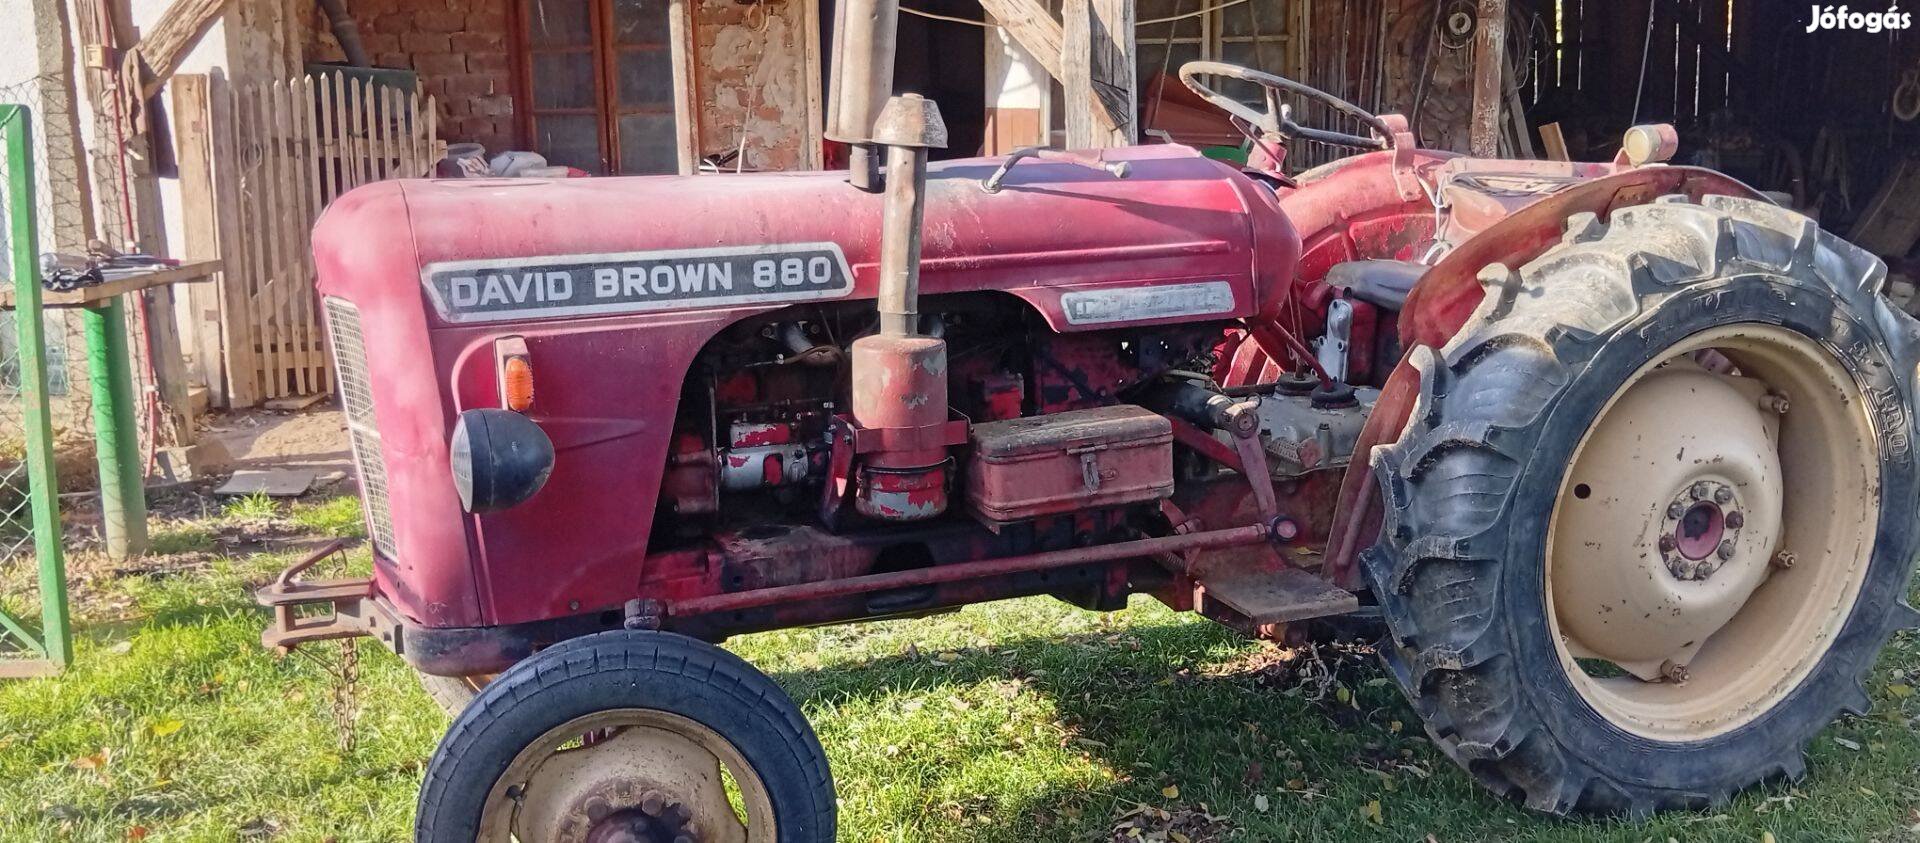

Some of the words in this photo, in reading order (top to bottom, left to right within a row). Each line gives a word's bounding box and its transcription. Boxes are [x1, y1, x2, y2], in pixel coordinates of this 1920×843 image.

[450, 271, 573, 308] DAVID
[594, 261, 733, 299] BROWN
[752, 256, 832, 289] 880
